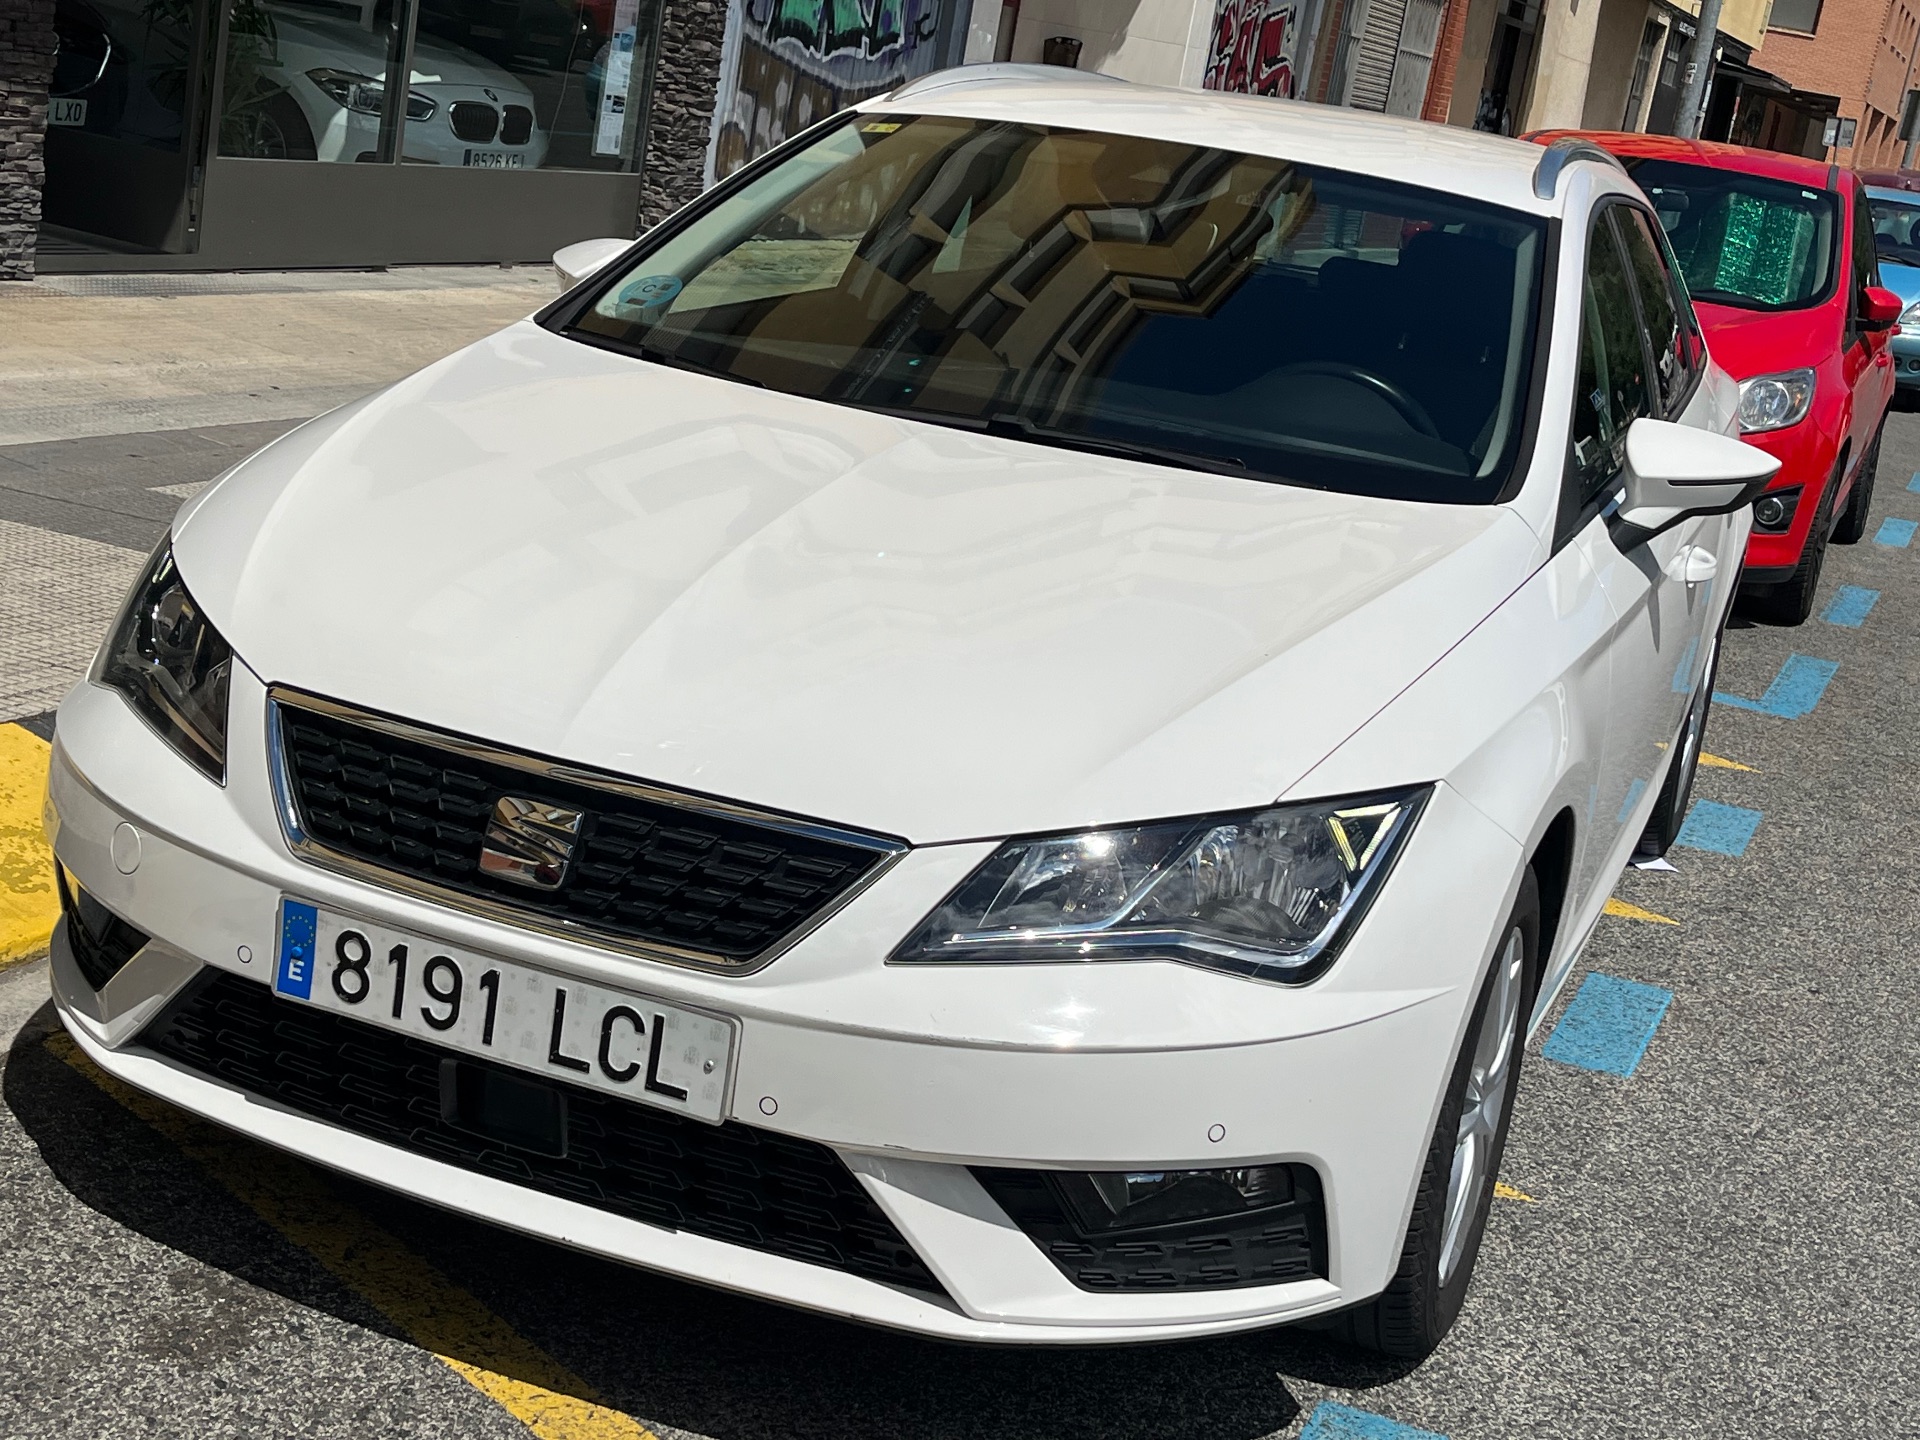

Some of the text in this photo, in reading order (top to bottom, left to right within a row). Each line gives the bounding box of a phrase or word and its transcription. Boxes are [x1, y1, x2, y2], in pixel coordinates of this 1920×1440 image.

[288, 958, 304, 981] E
[332, 929, 688, 1101] 8191 LCL
